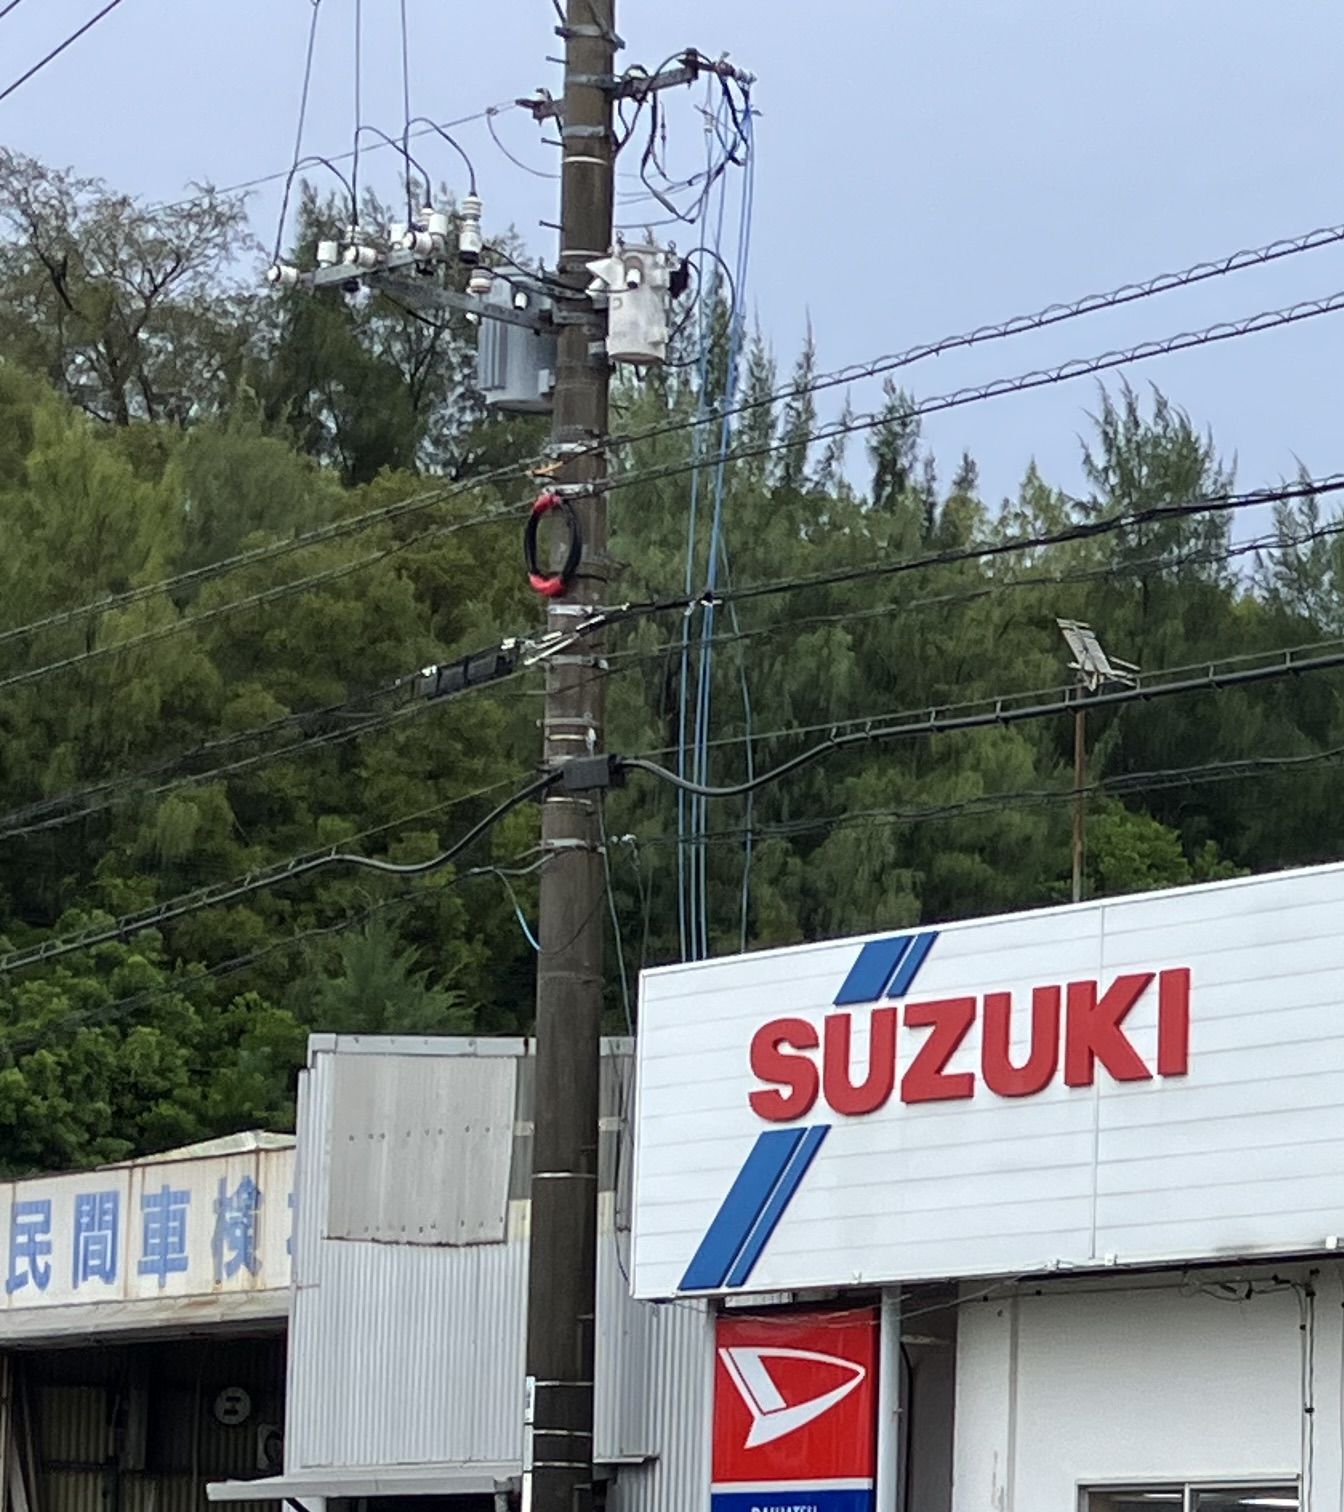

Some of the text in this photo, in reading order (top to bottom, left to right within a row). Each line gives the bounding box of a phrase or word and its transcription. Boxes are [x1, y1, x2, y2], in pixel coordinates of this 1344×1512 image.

[747, 966, 1191, 1122] SUZUKI
[5, 1174, 294, 1295] 民間車検
